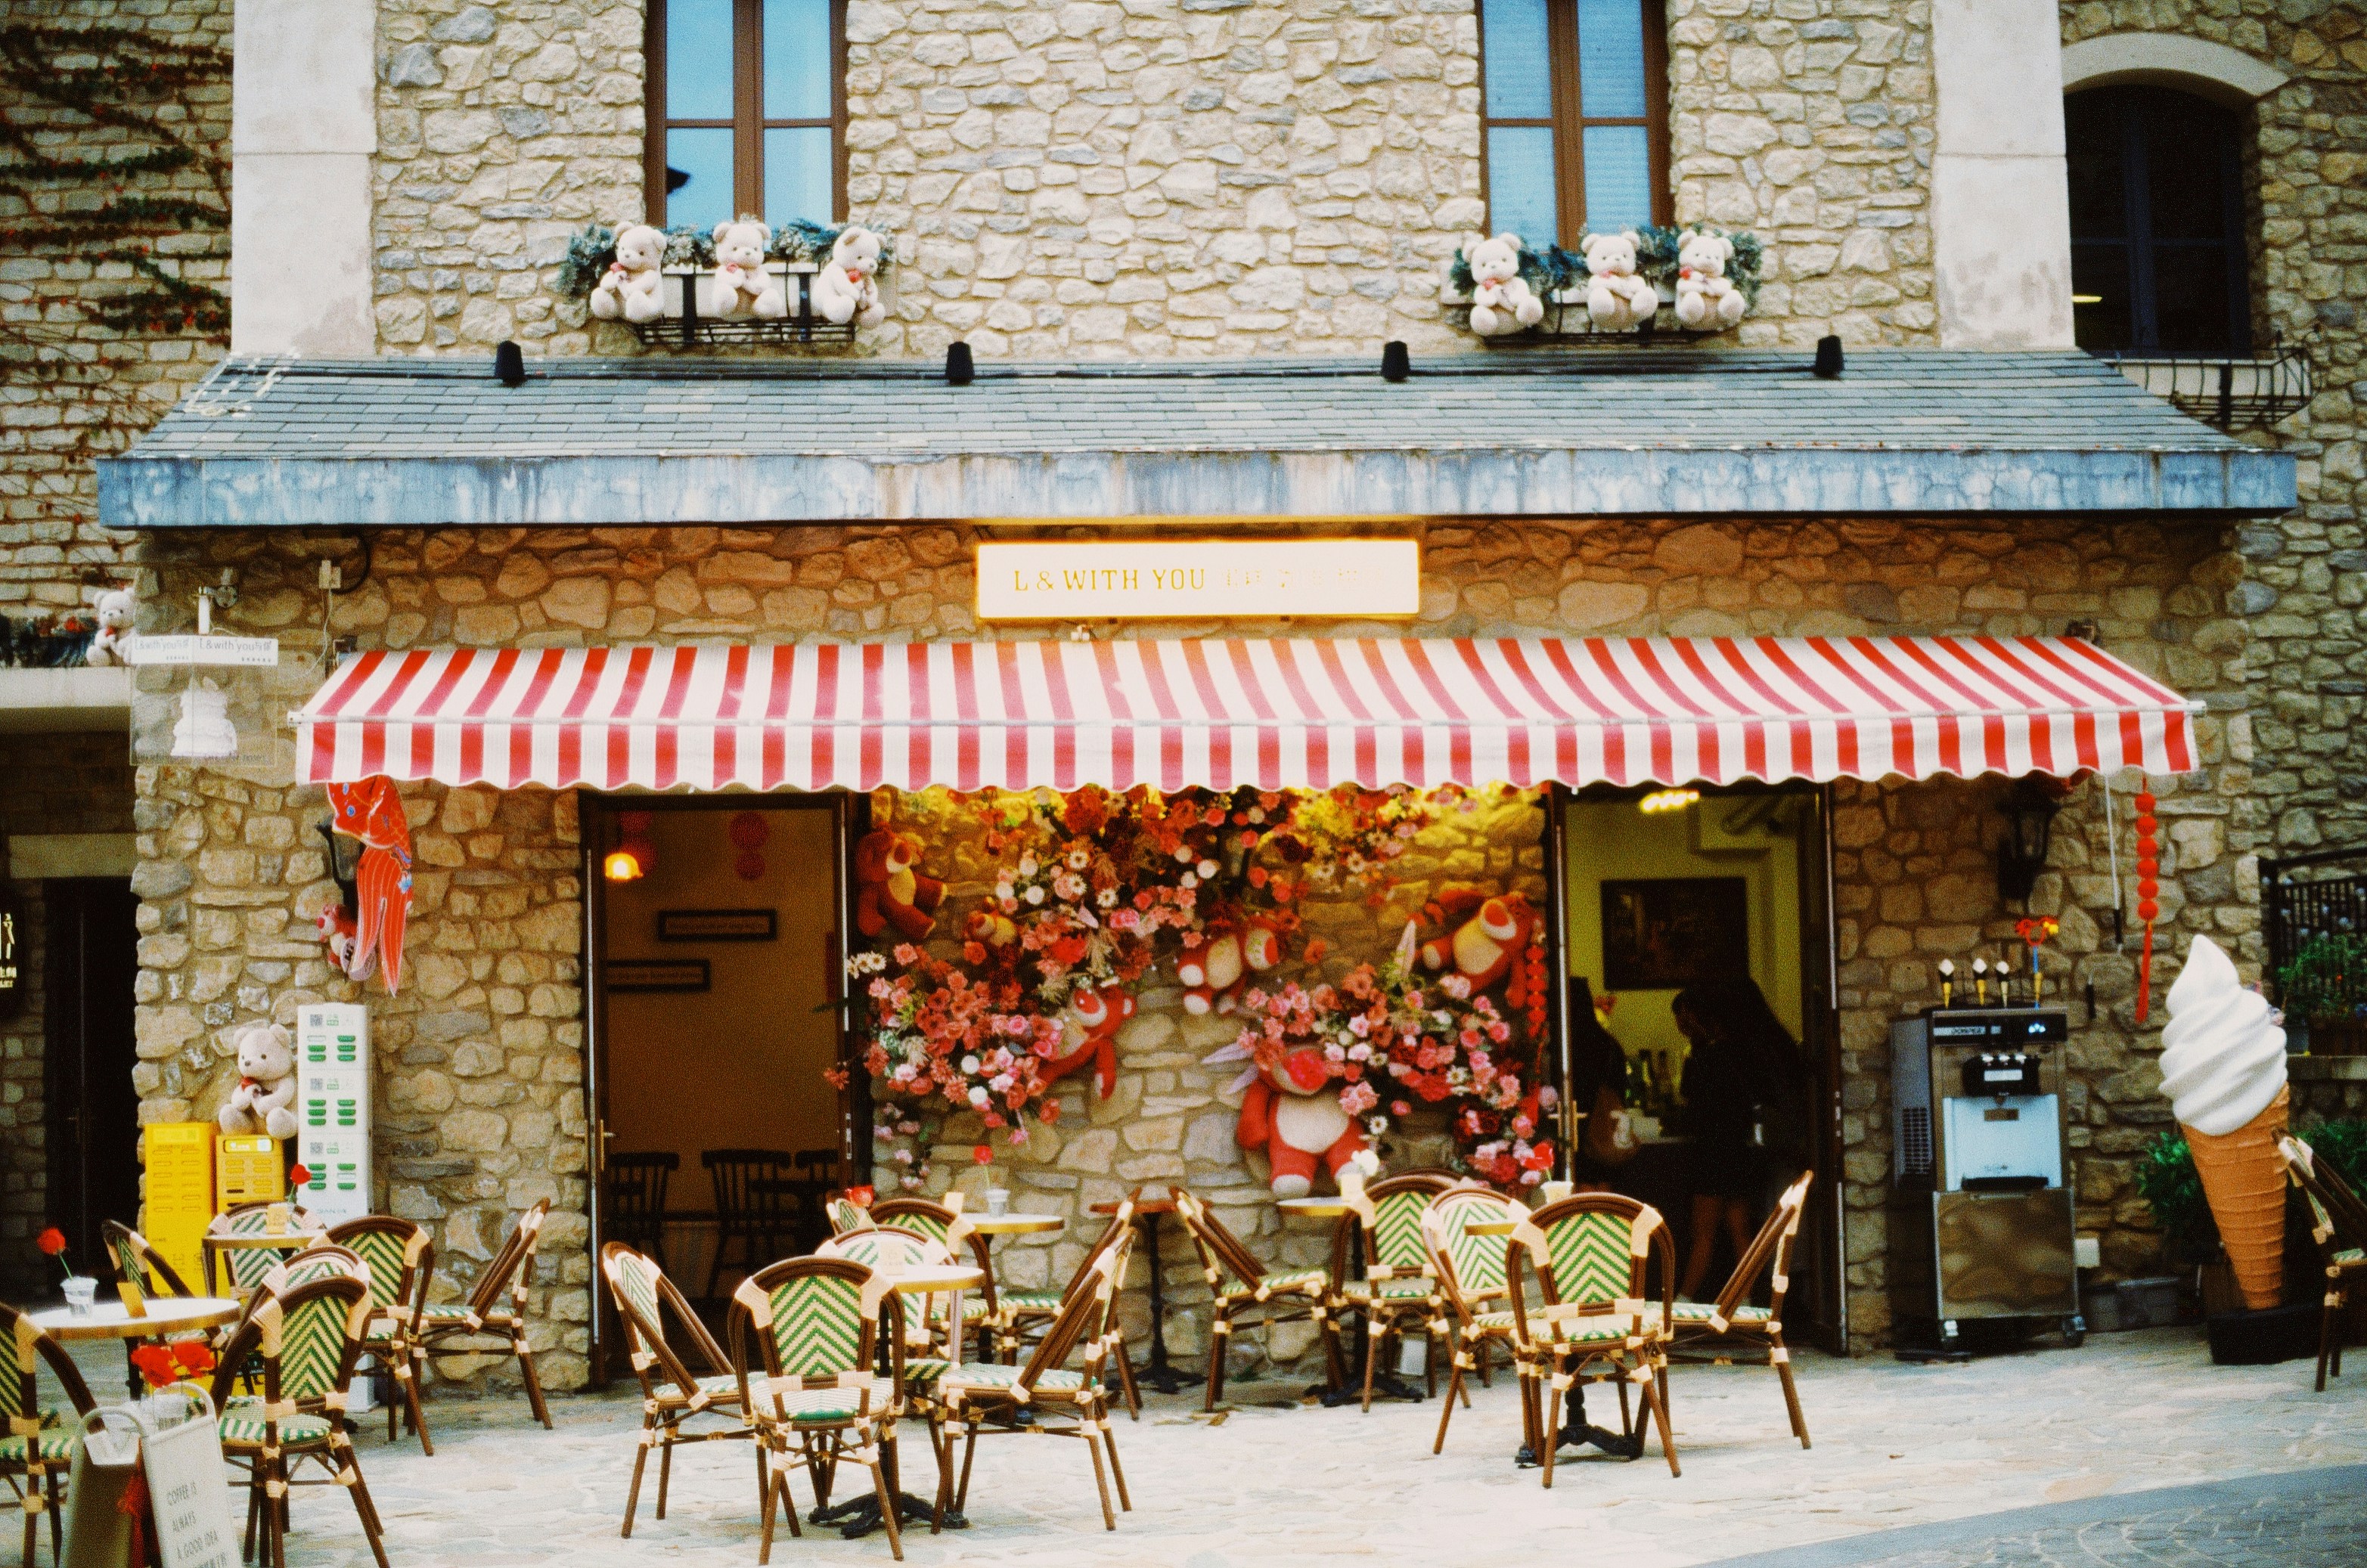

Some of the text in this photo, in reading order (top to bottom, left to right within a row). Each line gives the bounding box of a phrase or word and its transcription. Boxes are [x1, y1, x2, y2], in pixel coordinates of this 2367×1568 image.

[1014, 570, 1028, 591] L
[1036, 571, 1054, 591] &
[1063, 569, 1138, 590] WITH
[1152, 569, 1205, 590] YOU
